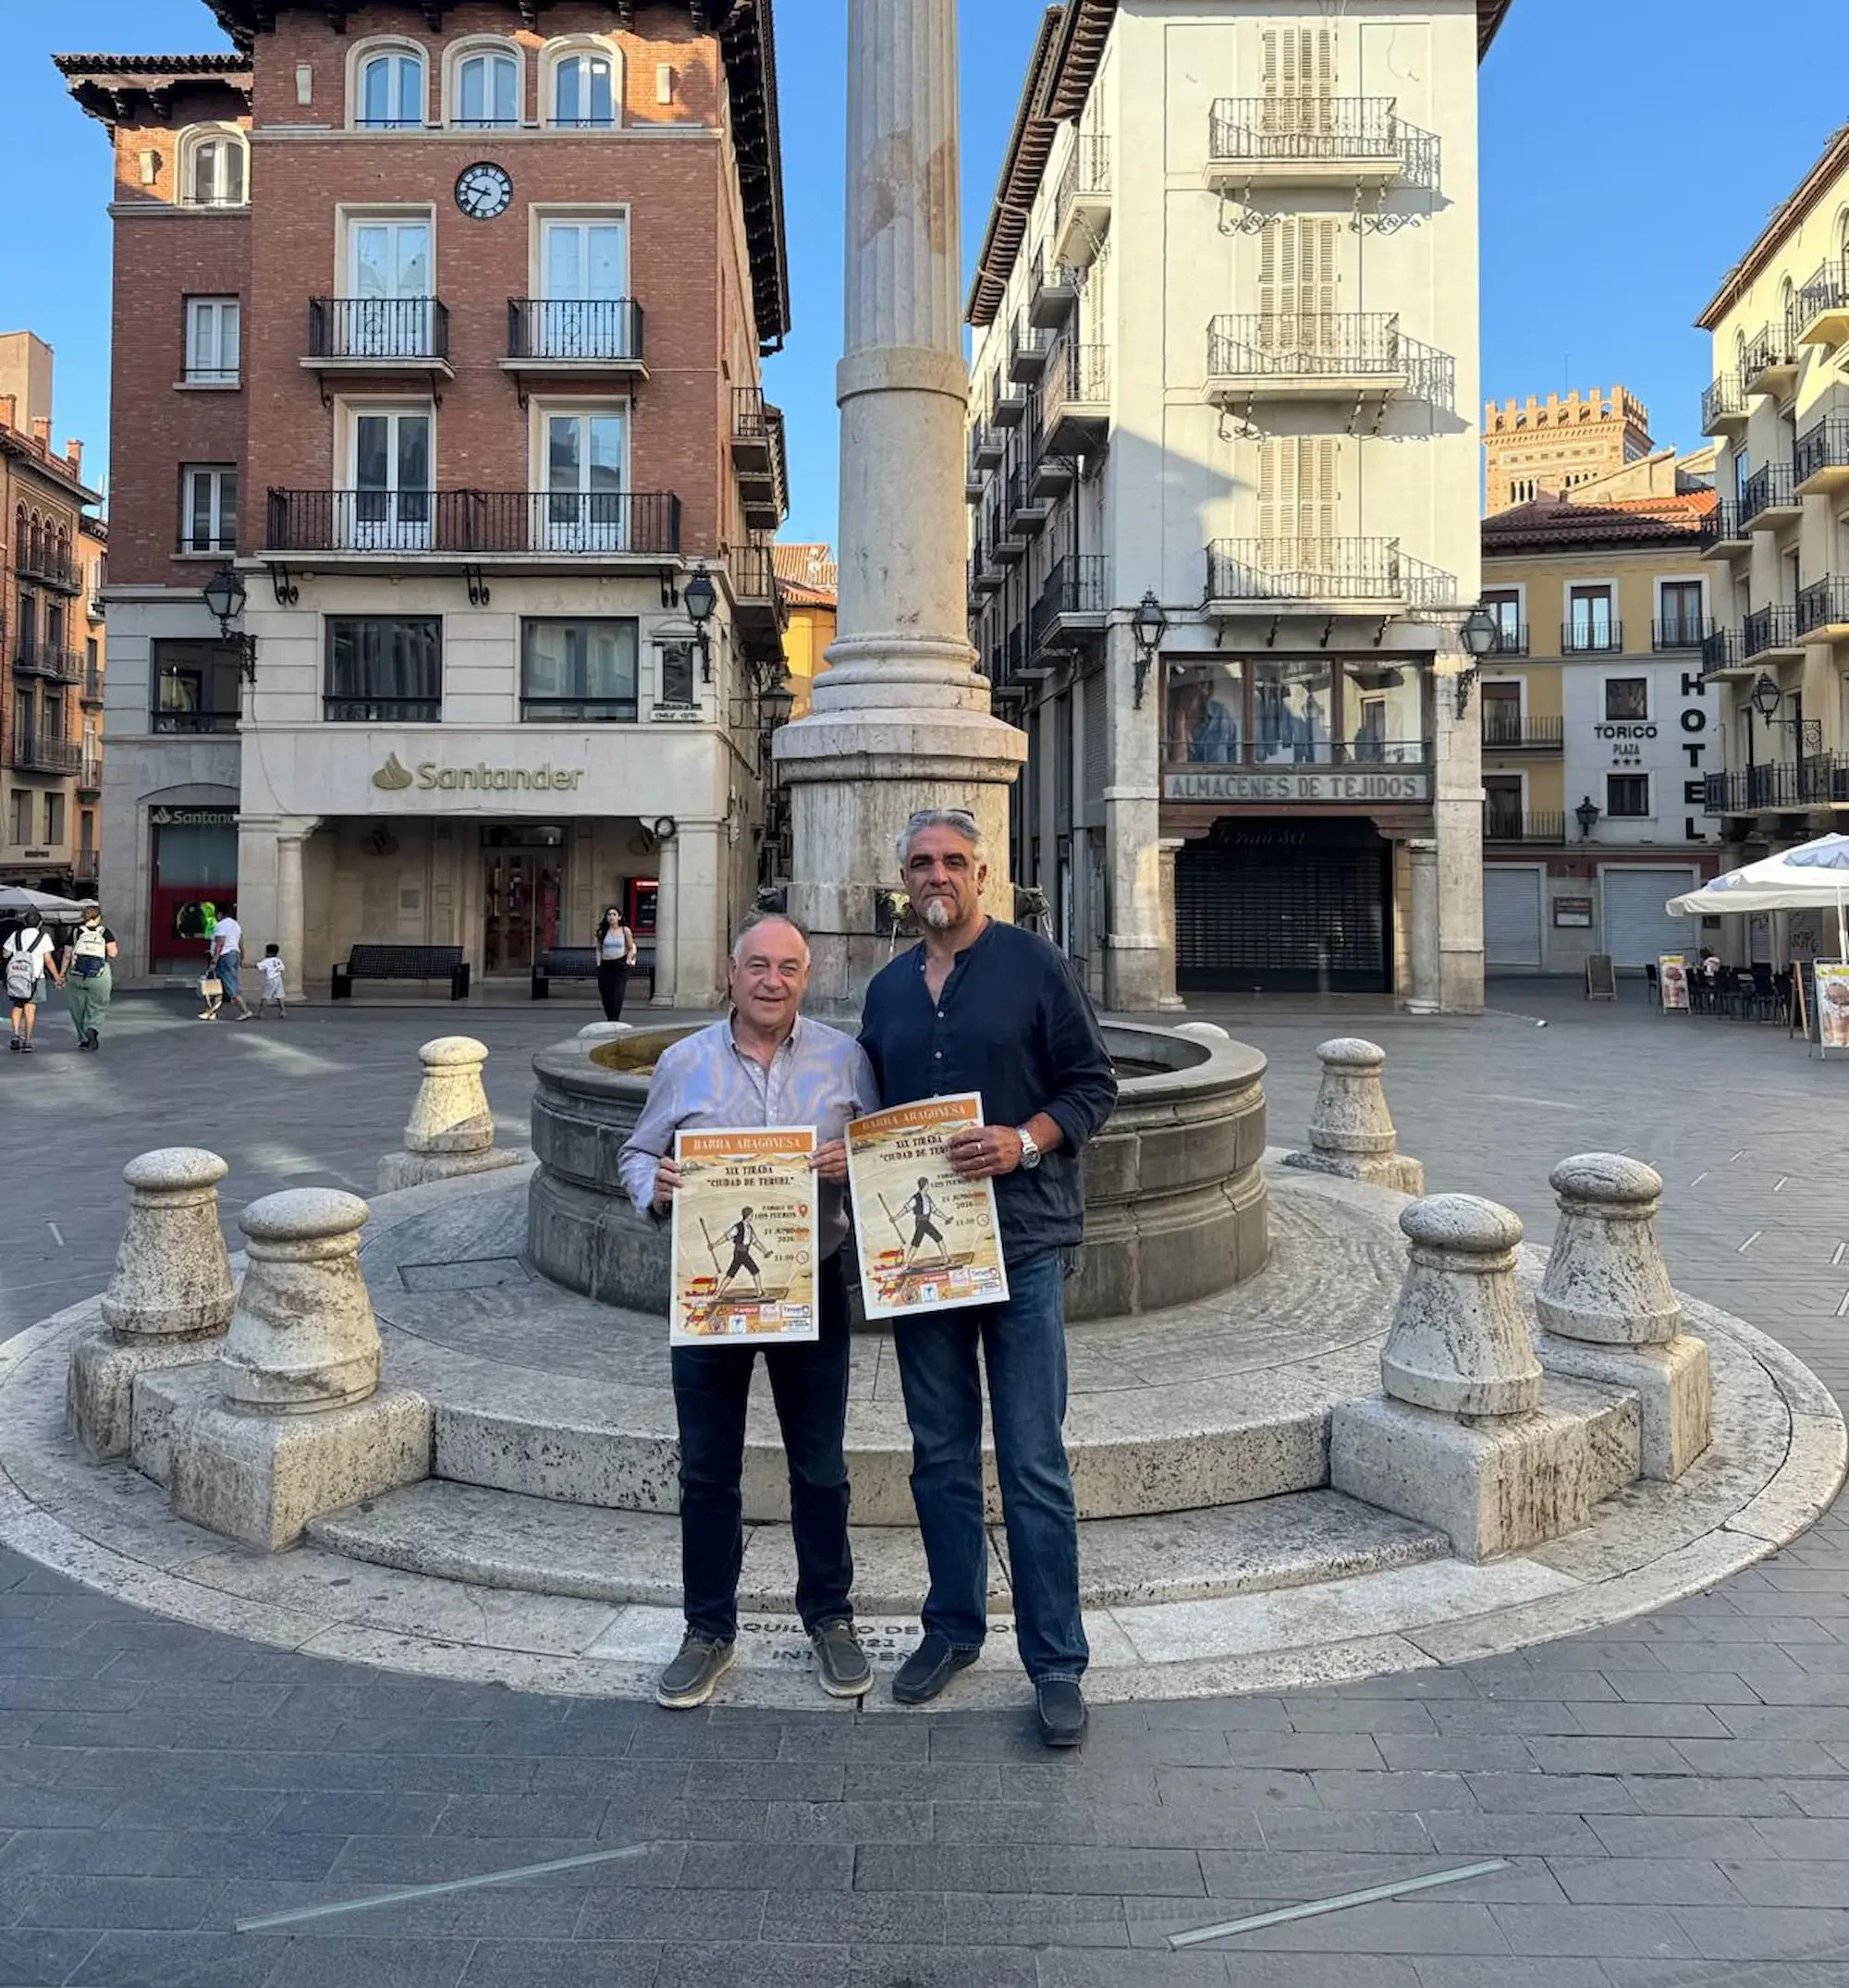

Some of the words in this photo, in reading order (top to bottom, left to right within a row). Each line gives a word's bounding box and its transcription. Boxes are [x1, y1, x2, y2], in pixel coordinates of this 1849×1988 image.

[1594, 726, 1658, 739] TORICO
[1613, 743, 1640, 755] PLAZA
[1681, 673, 1706, 840] HOTEL
[417, 762, 584, 790] Santander
[1171, 777, 1290, 798] ALMACENES
[1298, 777, 1319, 797] DE
[1330, 777, 1417, 797] TEJIDOS
[173, 811, 239, 824] Santand
[862, 1116, 898, 1130] BARRA
[903, 1104, 965, 1123] ARAGONESA
[693, 1138, 731, 1151] BARRA
[736, 1137, 802, 1150] ARAGONESA
[912, 1135, 942, 1147] TIRADA
[916, 1148, 926, 1157] DE
[742, 1165, 774, 1175] TIRADA
[744, 1178, 755, 1186] DE
[885, 1626, 919, 1635] DE
